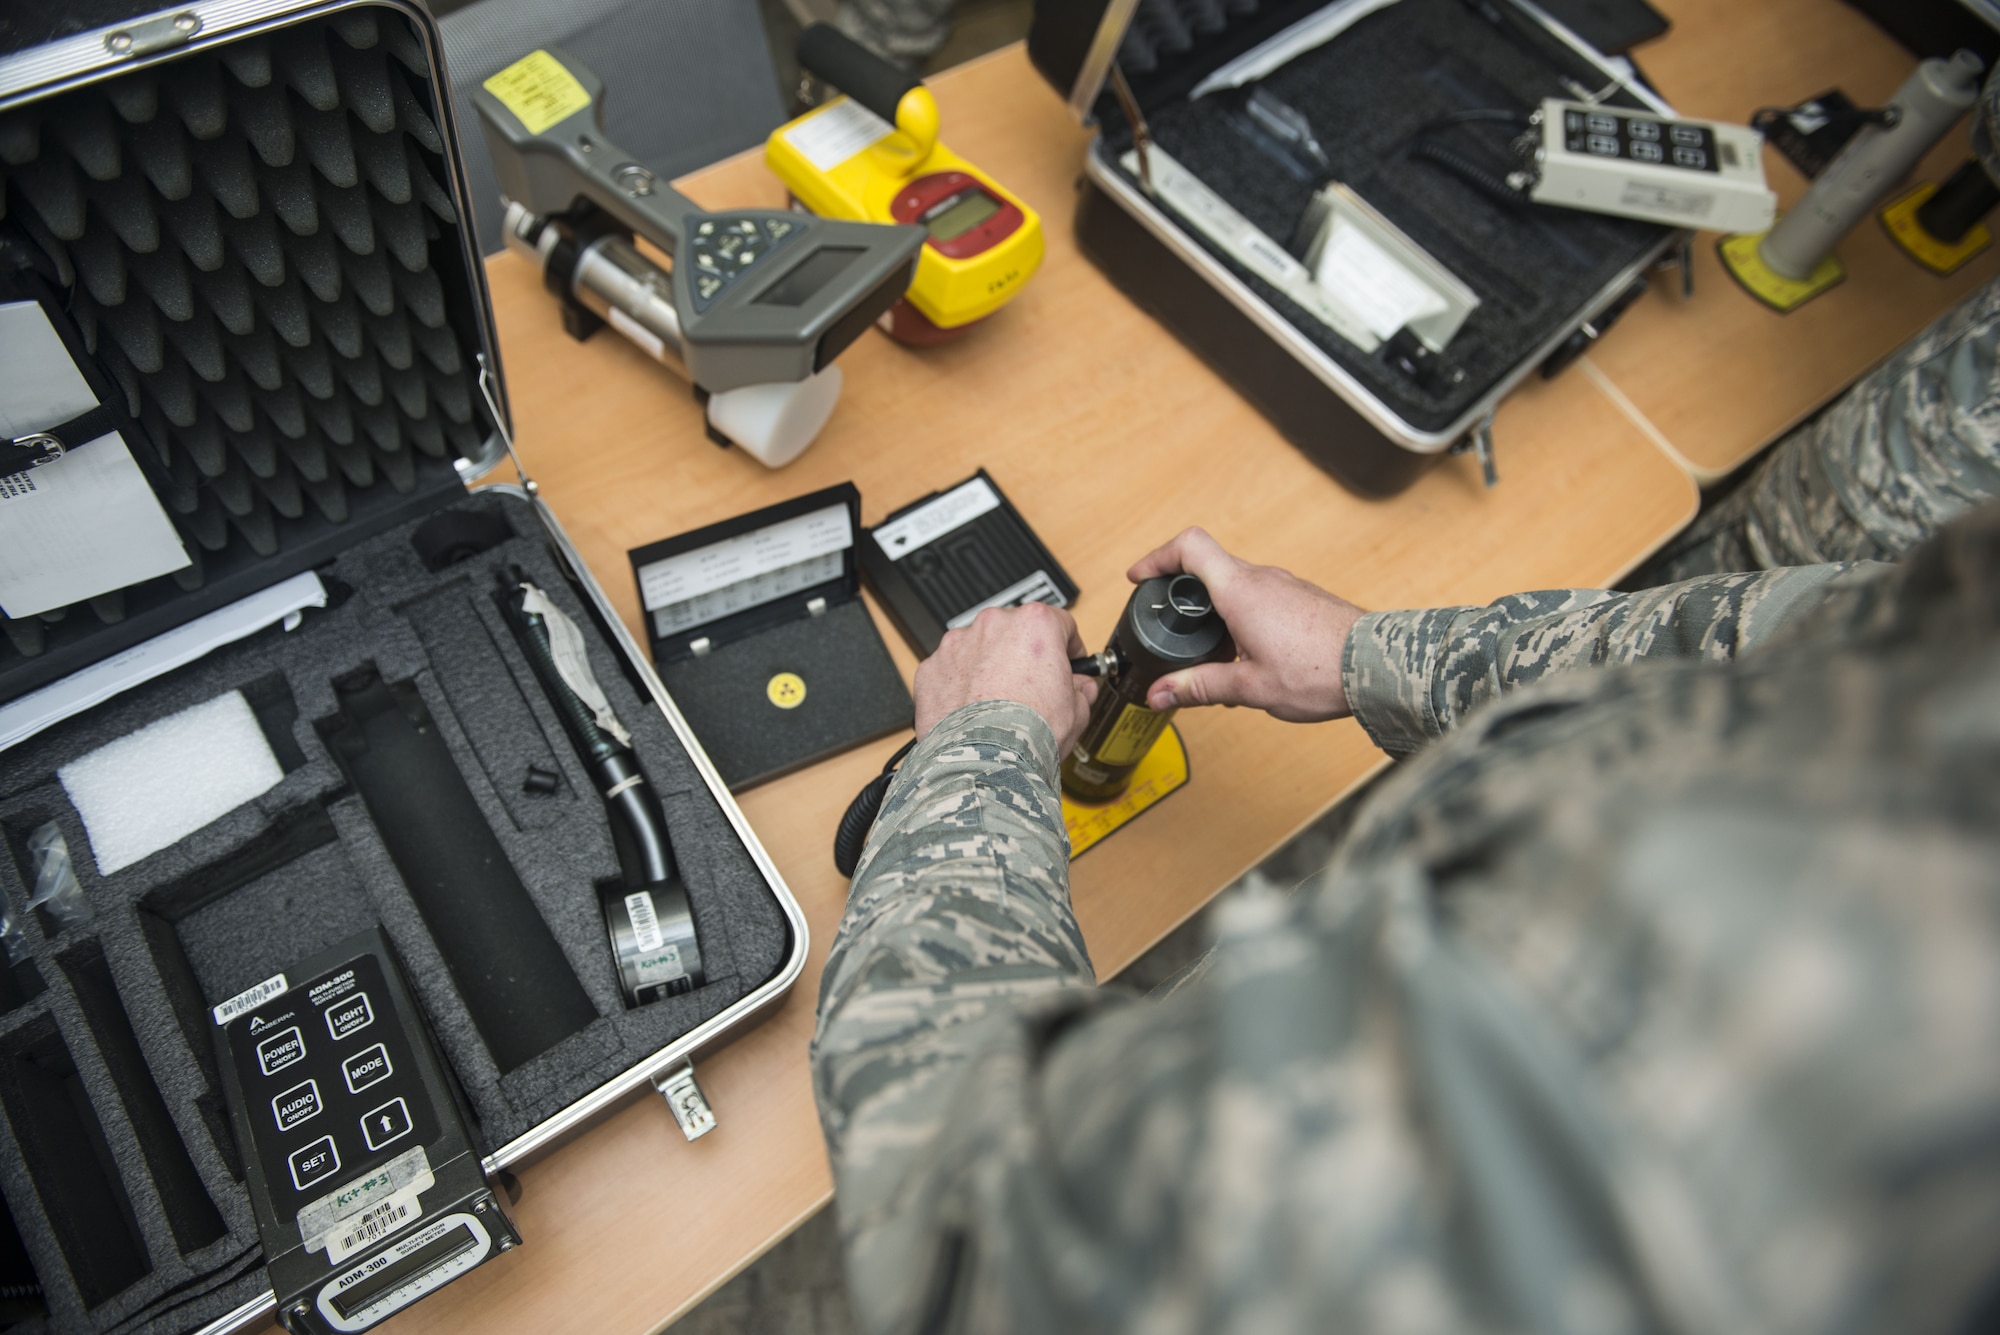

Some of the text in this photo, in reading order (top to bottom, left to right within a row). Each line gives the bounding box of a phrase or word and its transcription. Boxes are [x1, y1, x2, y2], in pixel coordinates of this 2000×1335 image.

[308, 970, 354, 998] ADM-300
[251, 1012, 295, 1036] CANBERRA
[334, 1005, 364, 1027] LIGHT
[340, 1016, 365, 1033] ON/OFF
[264, 1040, 299, 1063] POWER
[271, 1051, 297, 1068] ON/OFF
[351, 1057, 383, 1080] MODE
[281, 1093, 314, 1118] AUDIO
[287, 1106, 313, 1124] ON/OFF
[302, 1152, 327, 1172] SET
[337, 1189, 360, 1207] Kit
[367, 1229, 387, 1243] 7014
[395, 1222, 445, 1253] MULTI-FUNCTION
[401, 1228, 446, 1255] SURVEY METER
[338, 1257, 388, 1289] ADM-300
